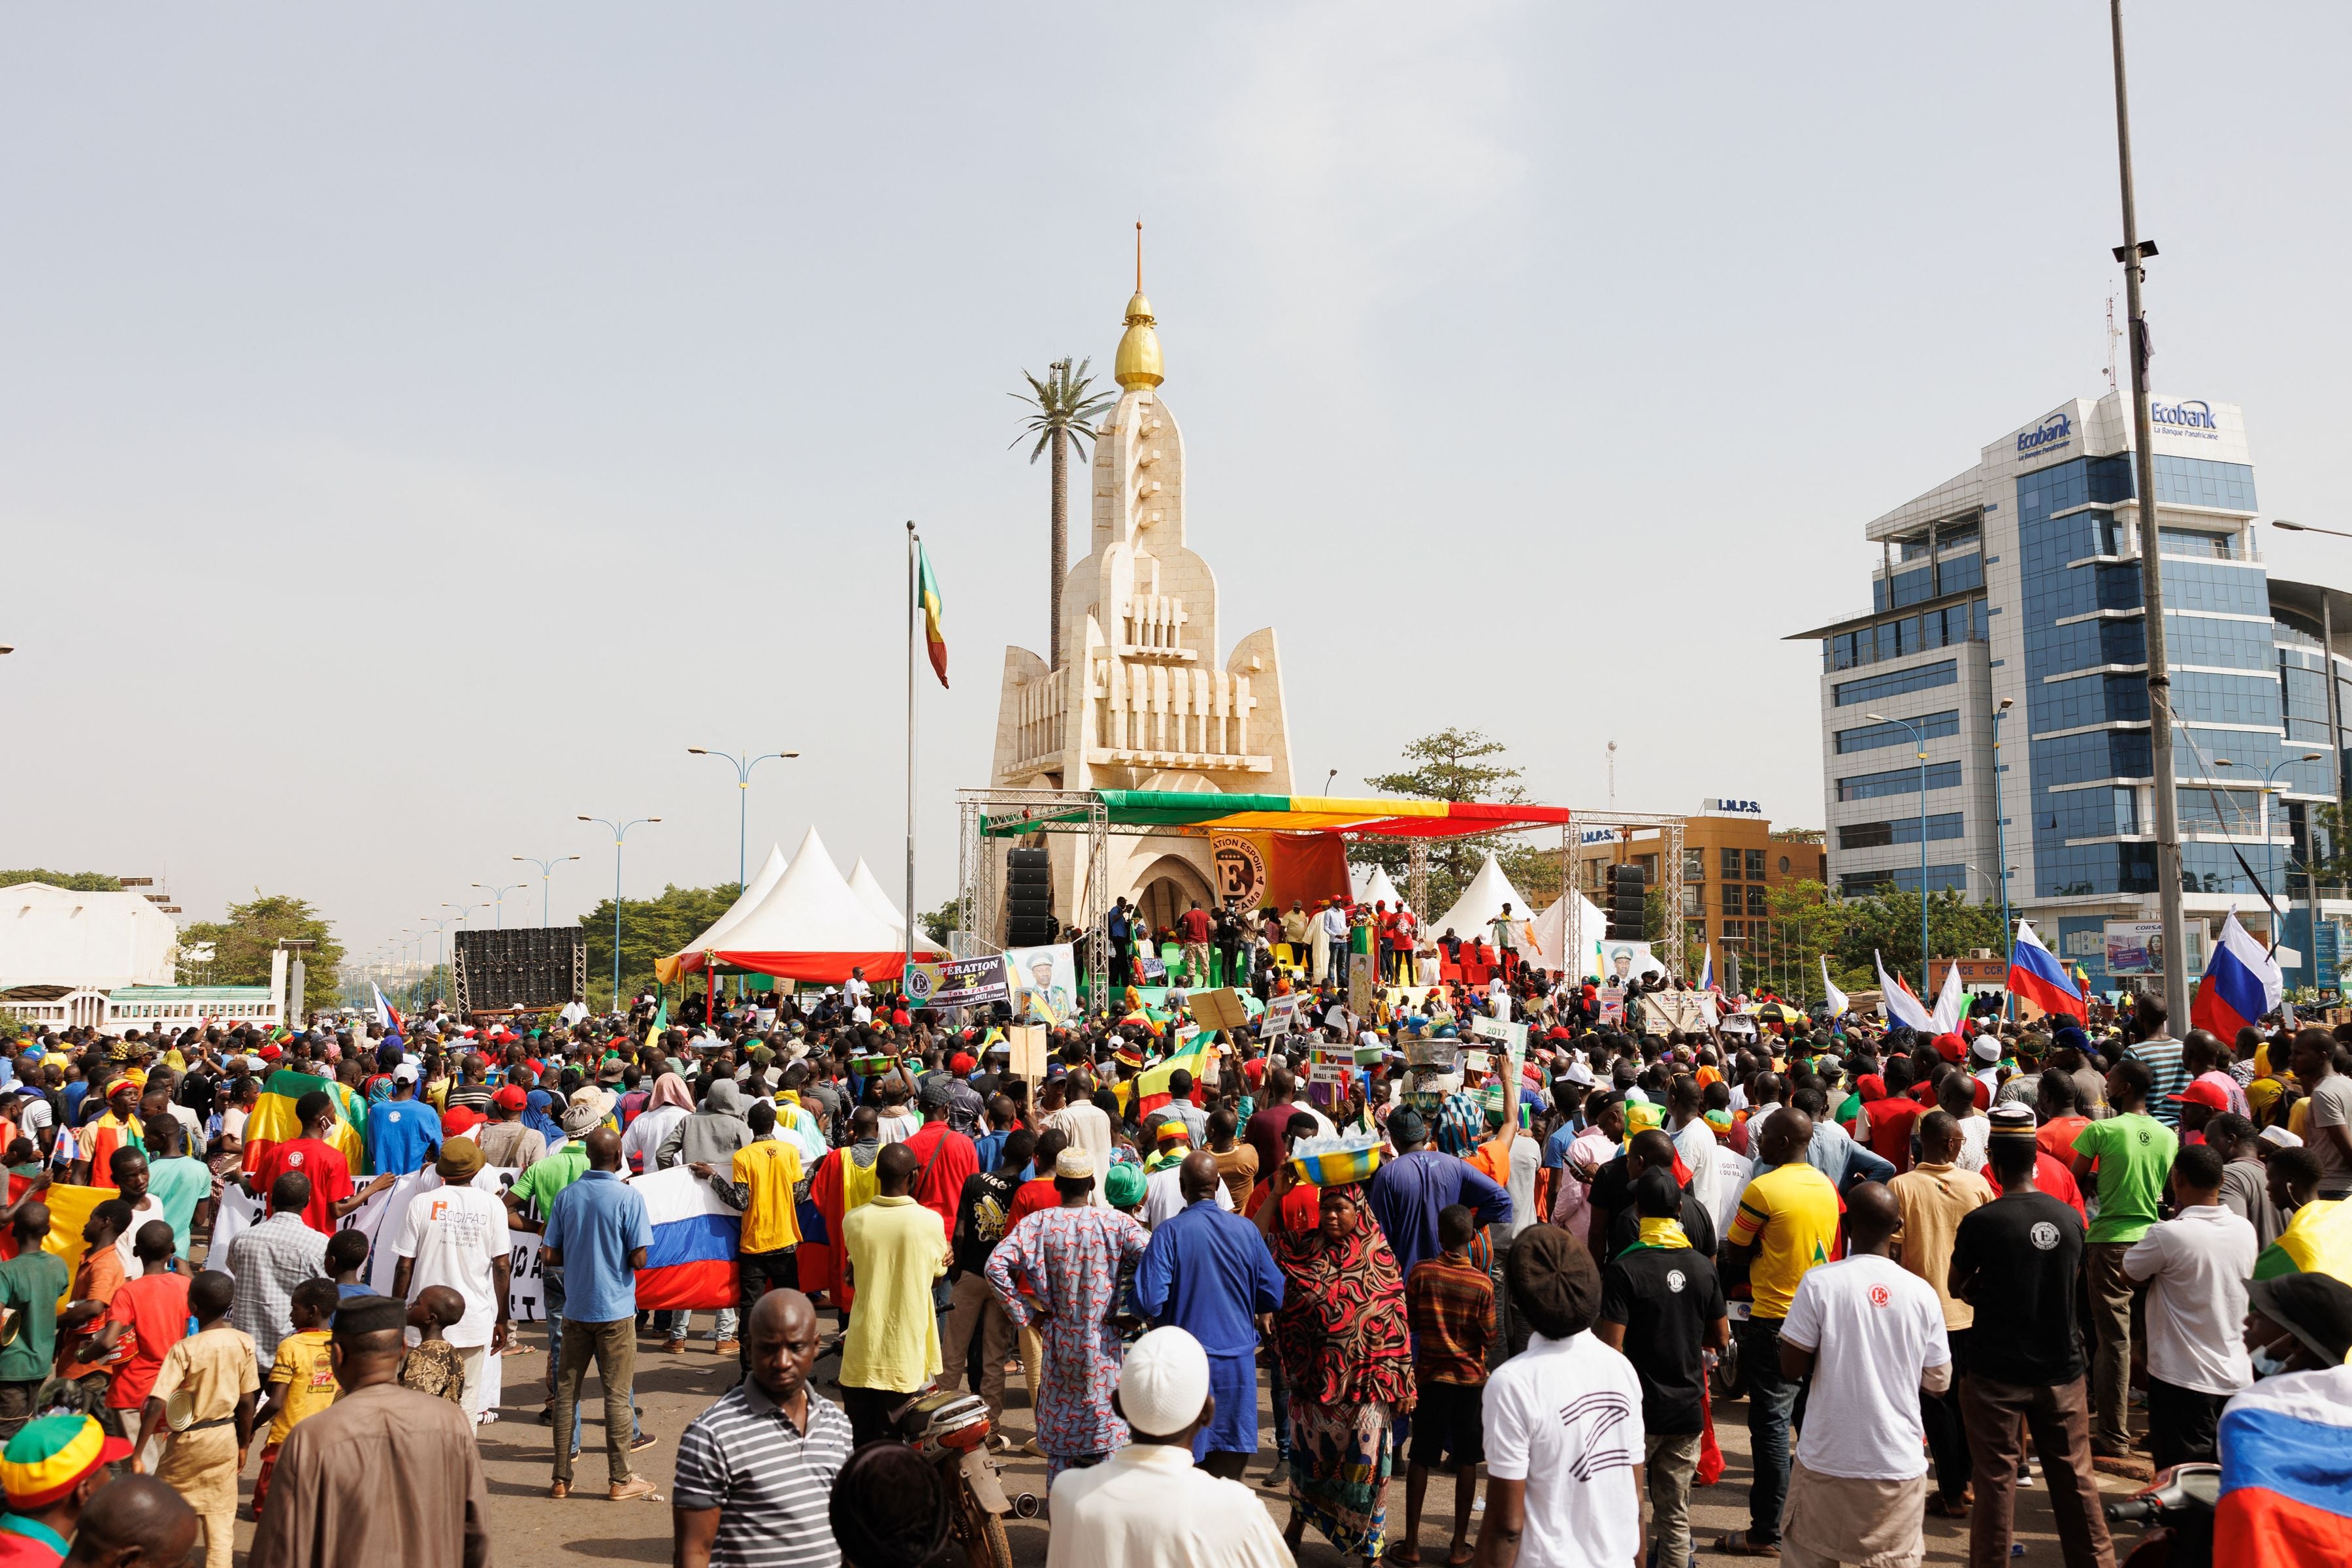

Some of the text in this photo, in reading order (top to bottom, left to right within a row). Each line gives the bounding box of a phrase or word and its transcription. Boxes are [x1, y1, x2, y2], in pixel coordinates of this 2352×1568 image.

[2151, 400, 2217, 429] Ecobank
[2017, 413, 2071, 451] Ecobank
[2162, 427, 2183, 436] Banque
[2185, 430, 2218, 440] Panafricaine
[2025, 449, 2042, 459] Banque
[2042, 440, 2070, 454] Panafricaine
[1718, 799, 1761, 813] I.N.P.S.
[1581, 829, 1614, 843] I.N.P.S.
[1240, 842, 1262, 872] ESPOIR
[1218, 860, 1246, 895] E
[933, 960, 999, 977] OPÉRATION
[1941, 966, 2003, 975] PICE CCR
[914, 977, 927, 990] E
[972, 985, 994, 993] FAMA
[975, 992, 987, 1001] OUI
[1486, 1026, 1507, 1037] 2017
[2040, 1230, 2051, 1241] E
